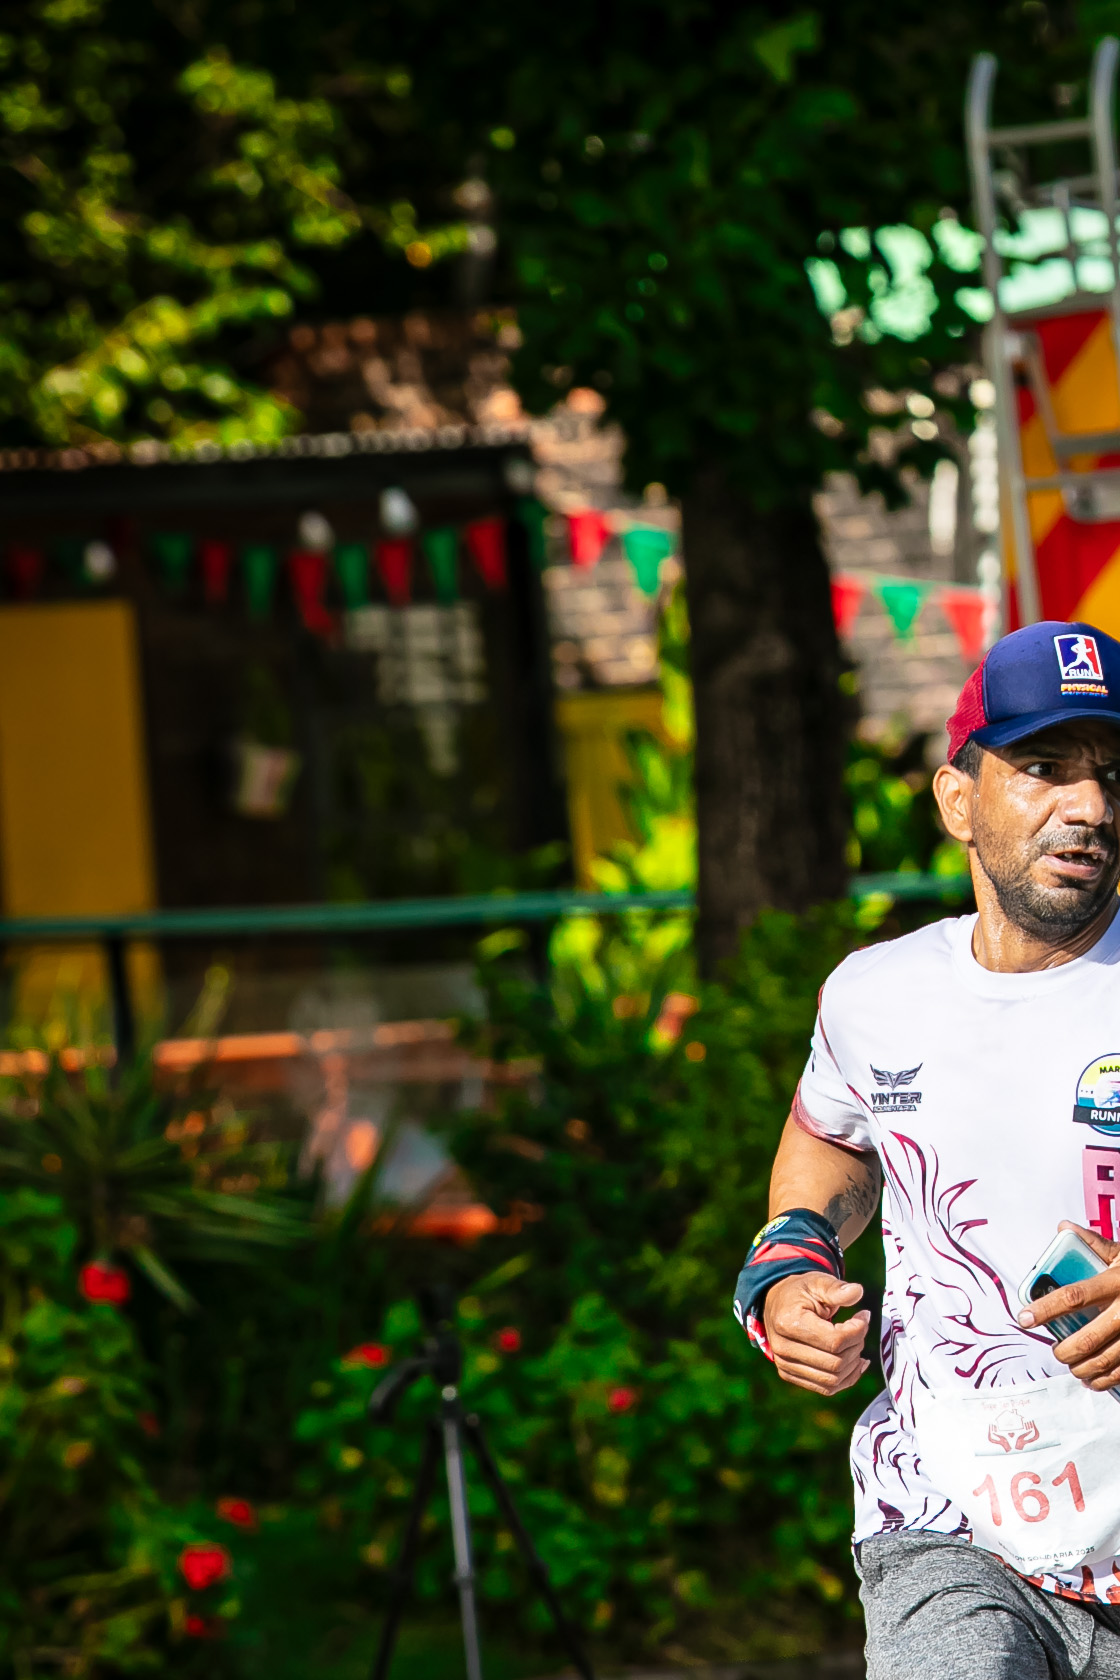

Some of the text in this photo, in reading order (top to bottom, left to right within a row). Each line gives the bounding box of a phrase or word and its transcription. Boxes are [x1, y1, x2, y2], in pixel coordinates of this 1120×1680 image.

[1068, 669, 1093, 677] RUN
[871, 1092, 922, 1105] VINTER
[972, 1461, 1085, 1527] 161
[1075, 1546, 1095, 1556] 2025
